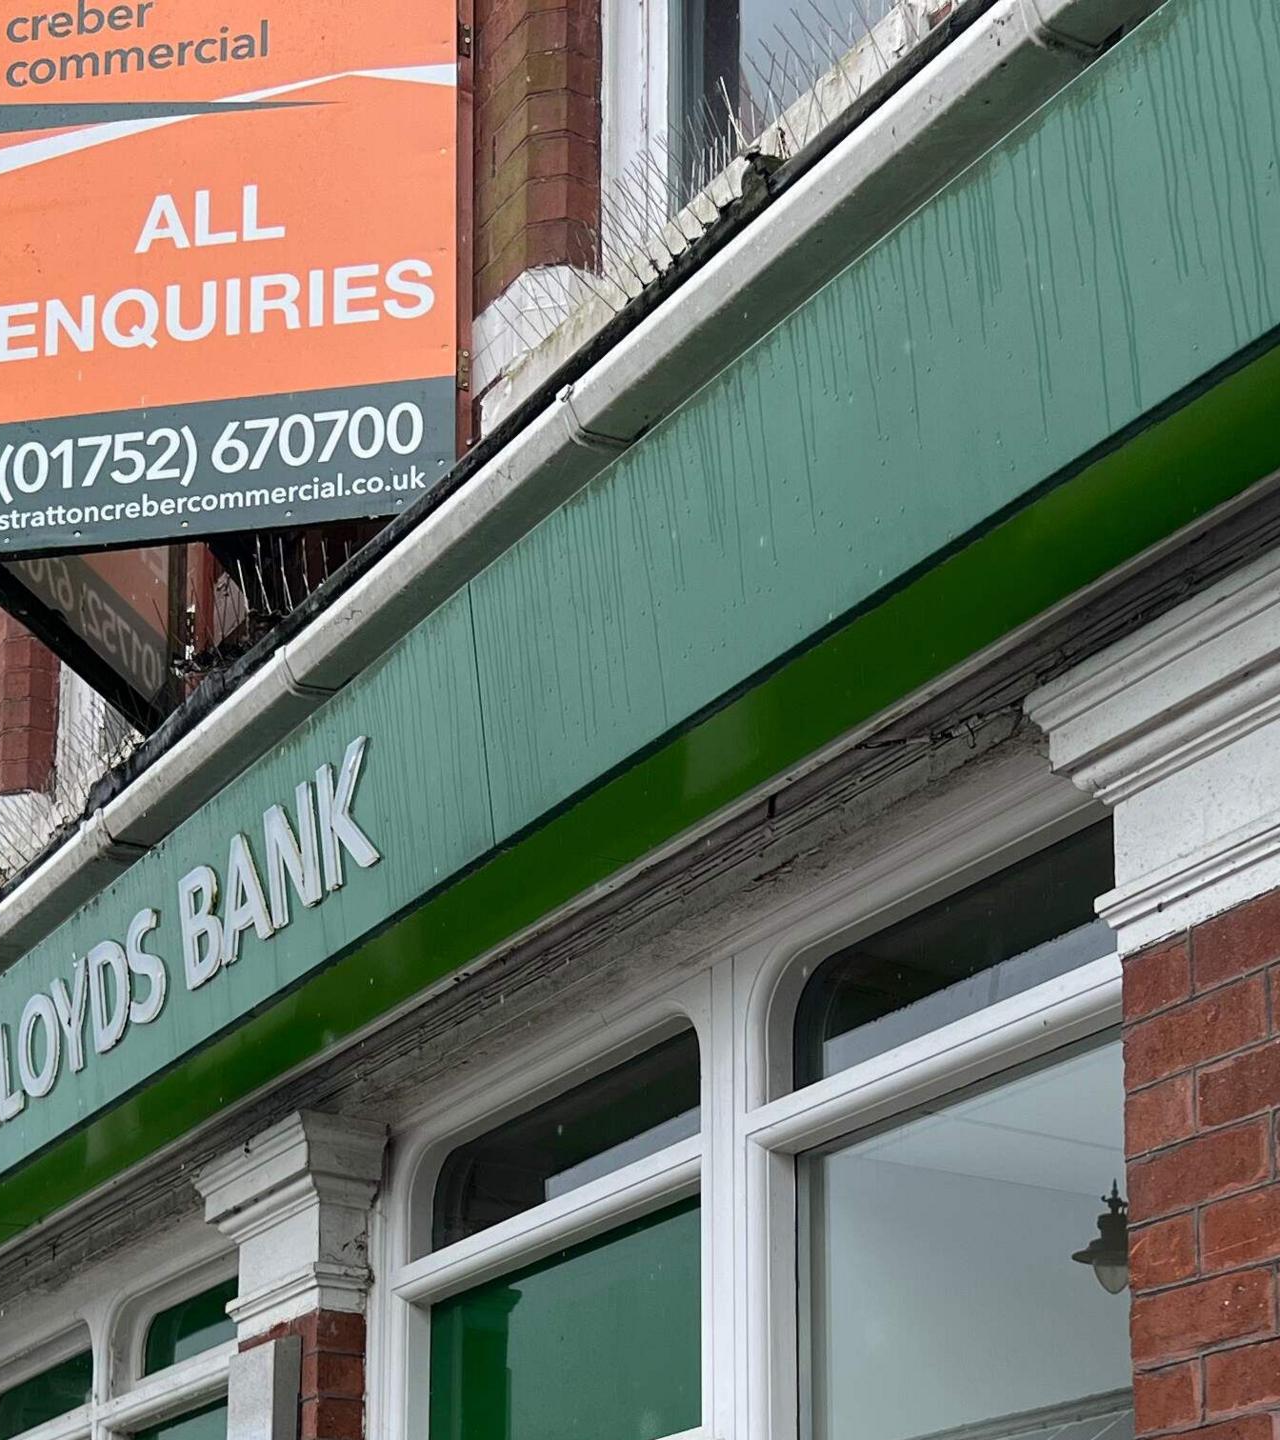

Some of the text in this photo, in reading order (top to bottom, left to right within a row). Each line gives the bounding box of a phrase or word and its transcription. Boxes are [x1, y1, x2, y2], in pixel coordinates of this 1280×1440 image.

[6, 0, 154, 42] creber
[6, 20, 268, 88] commercial
[135, 185, 286, 254] ALL
[211, 402, 423, 475] 670700
[178, 735, 382, 990] BANK
